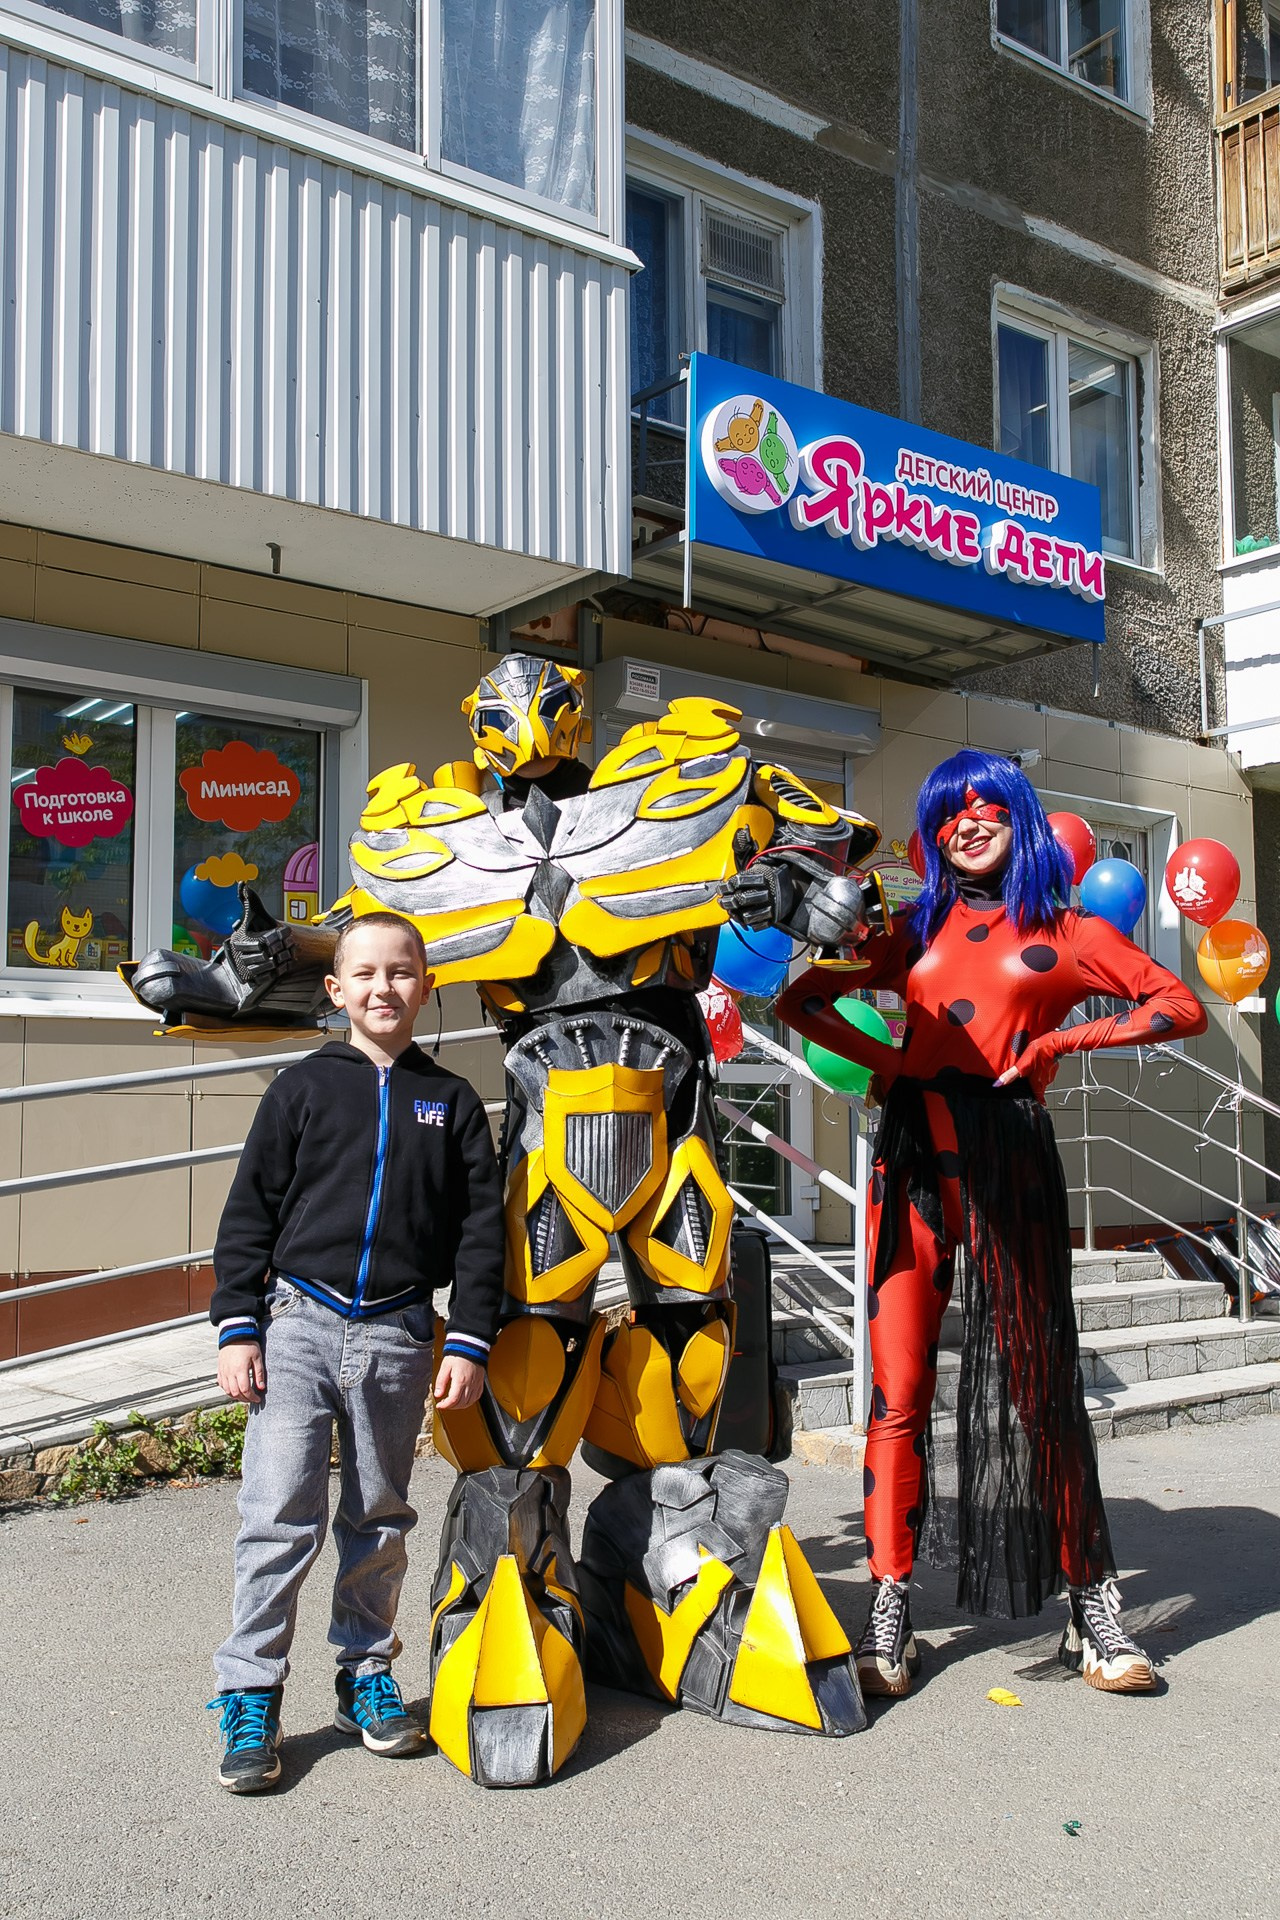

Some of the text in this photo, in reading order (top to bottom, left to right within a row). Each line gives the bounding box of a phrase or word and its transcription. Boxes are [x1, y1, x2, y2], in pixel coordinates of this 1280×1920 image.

[898, 449, 1058, 520] ДЕТСКИЙ ЦЕНТР
[200, 780, 291, 799] Минисад
[23, 789, 126, 810] Подготовка
[42, 807, 114, 825] к школе
[417, 1108, 445, 1127] LIFE
